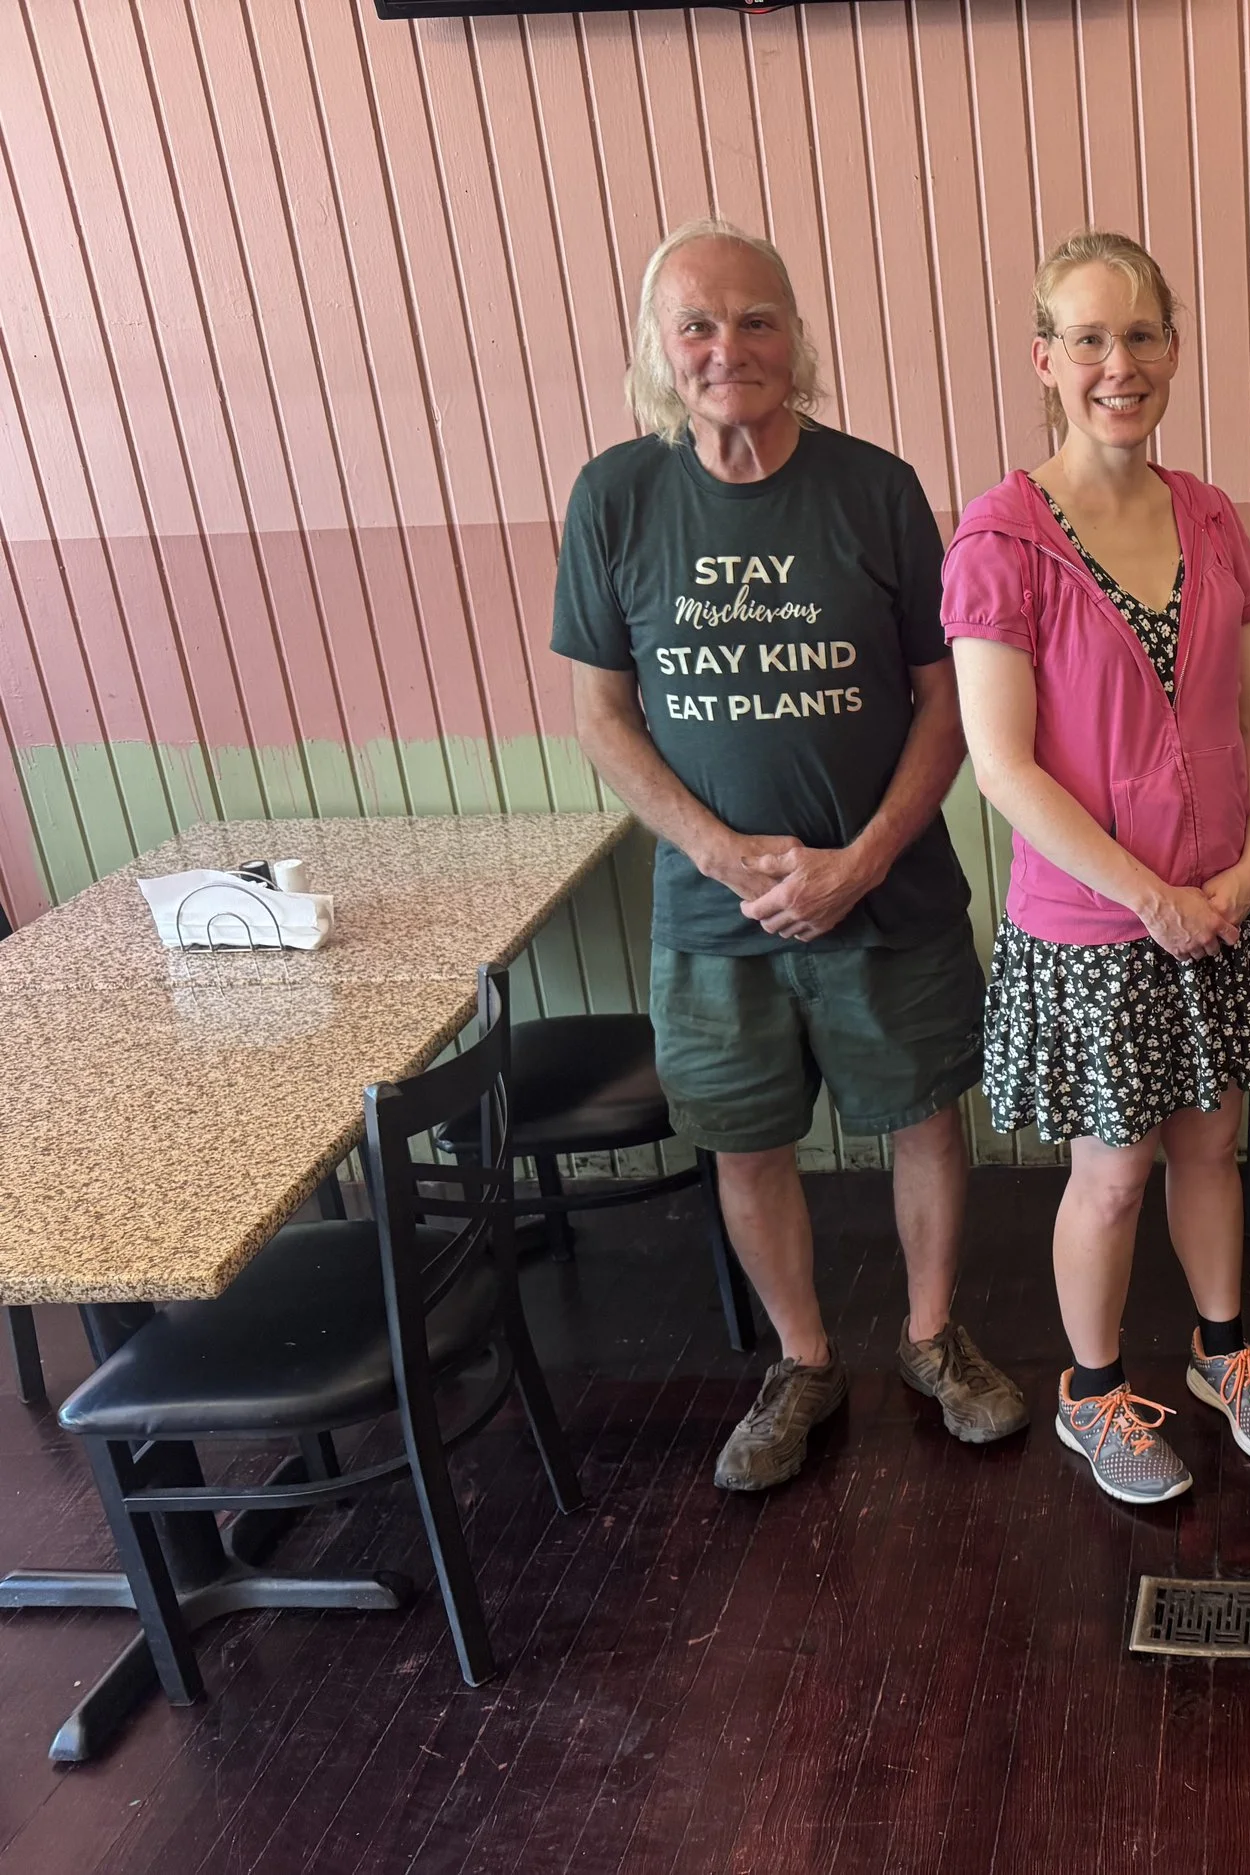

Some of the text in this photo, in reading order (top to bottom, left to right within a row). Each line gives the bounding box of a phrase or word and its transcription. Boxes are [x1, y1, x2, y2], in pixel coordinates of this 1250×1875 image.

[694, 555, 795, 585] STAY
[675, 584, 822, 630] Mischievous
[656, 640, 857, 675] STAY KIND
[666, 687, 863, 721] EAT PLANTS
